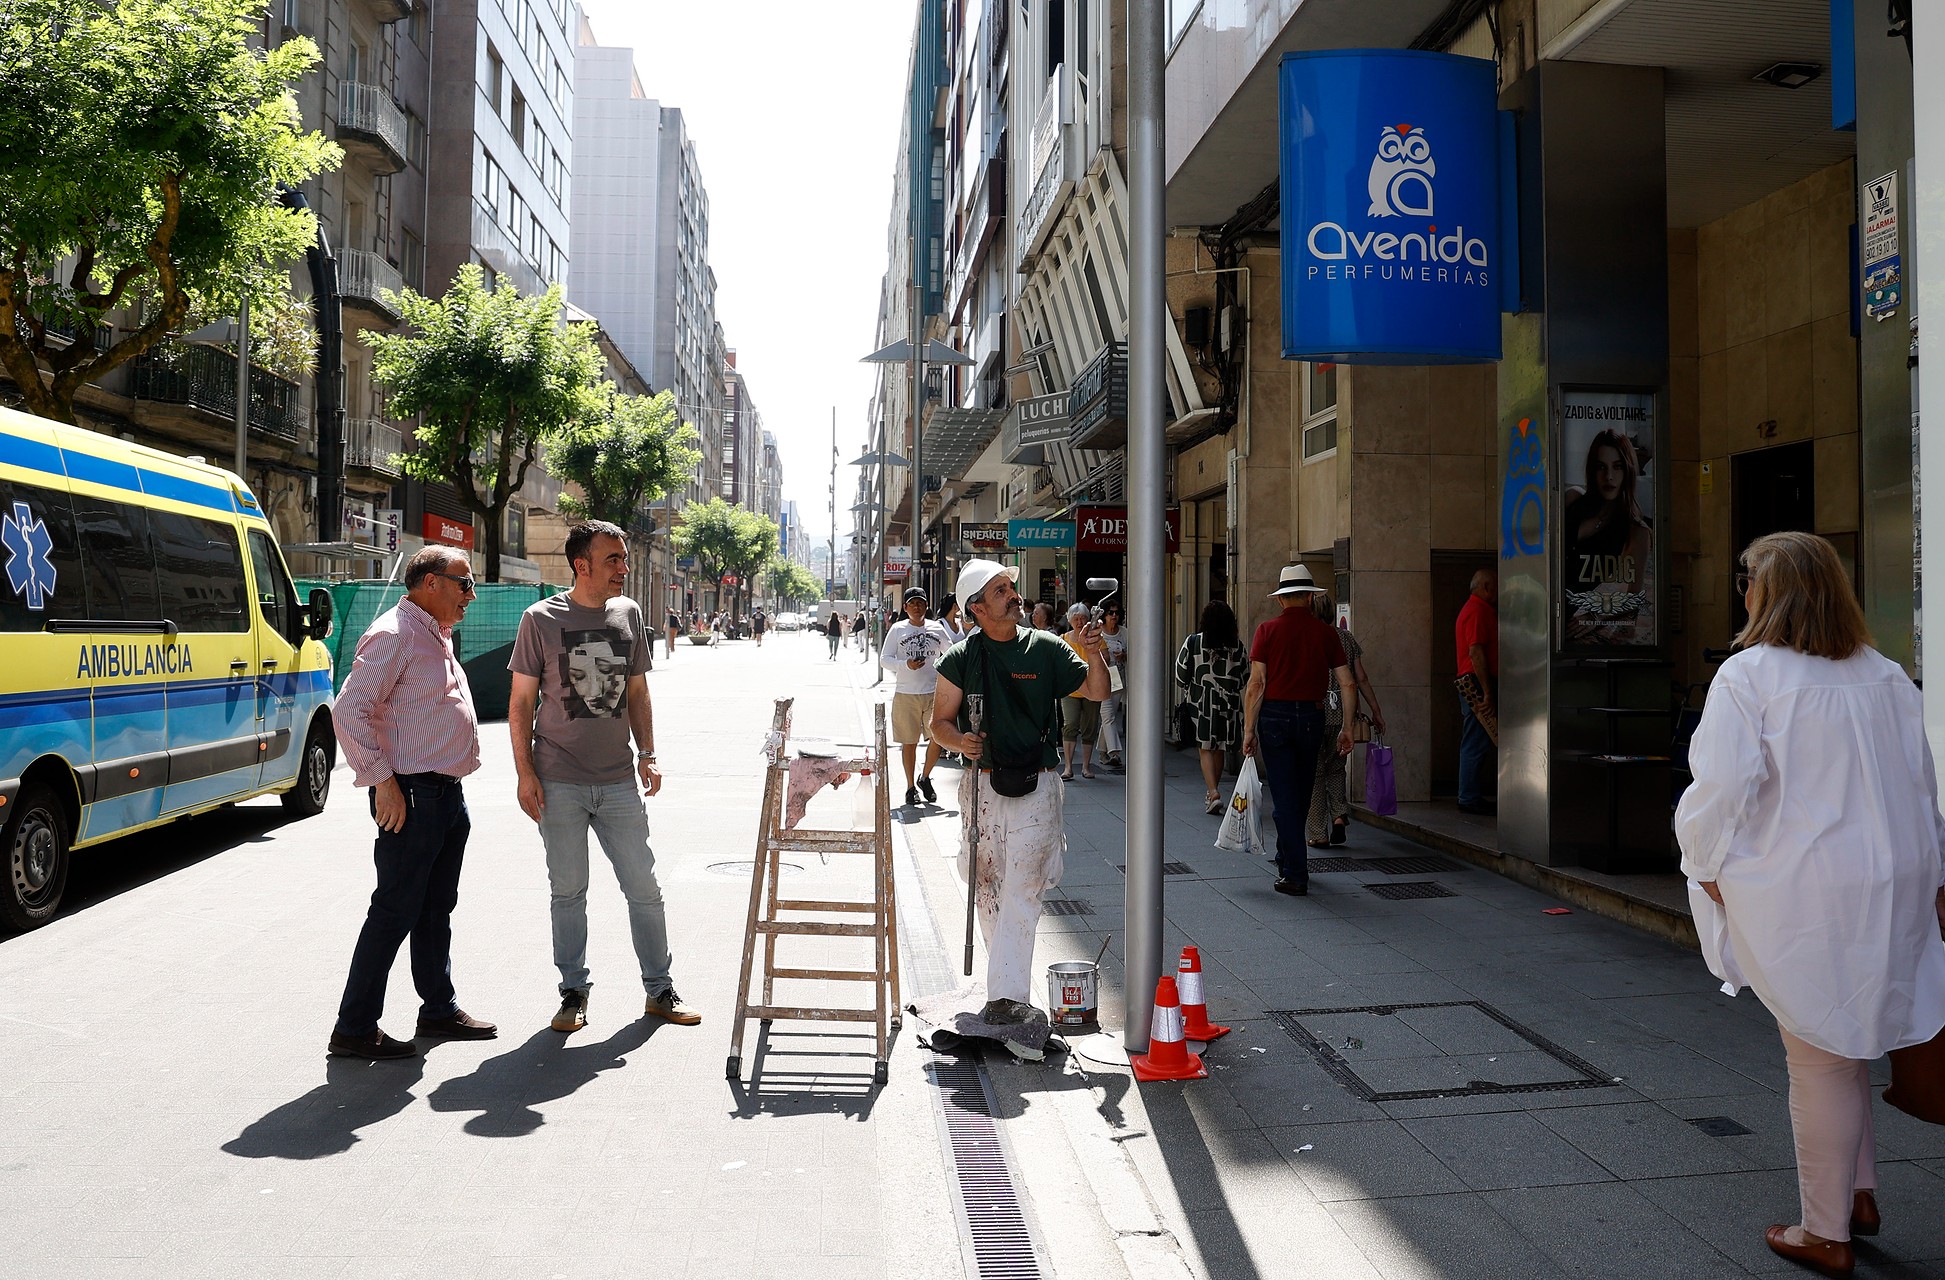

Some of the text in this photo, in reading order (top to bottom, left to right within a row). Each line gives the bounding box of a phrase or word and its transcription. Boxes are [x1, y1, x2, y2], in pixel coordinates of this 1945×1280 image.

[1866, 216, 1896, 234] ¡ALARMA!
[1307, 221, 1488, 267] avenida
[1308, 265, 1488, 286] PERFUMERÍAS
[1757, 420, 1778, 439] 12
[1016, 527, 1069, 539] ATLEET
[1102, 537, 1128, 545] FORNO
[1578, 554, 1636, 584] ZADIG
[77, 643, 193, 679] AMBULANCIA
